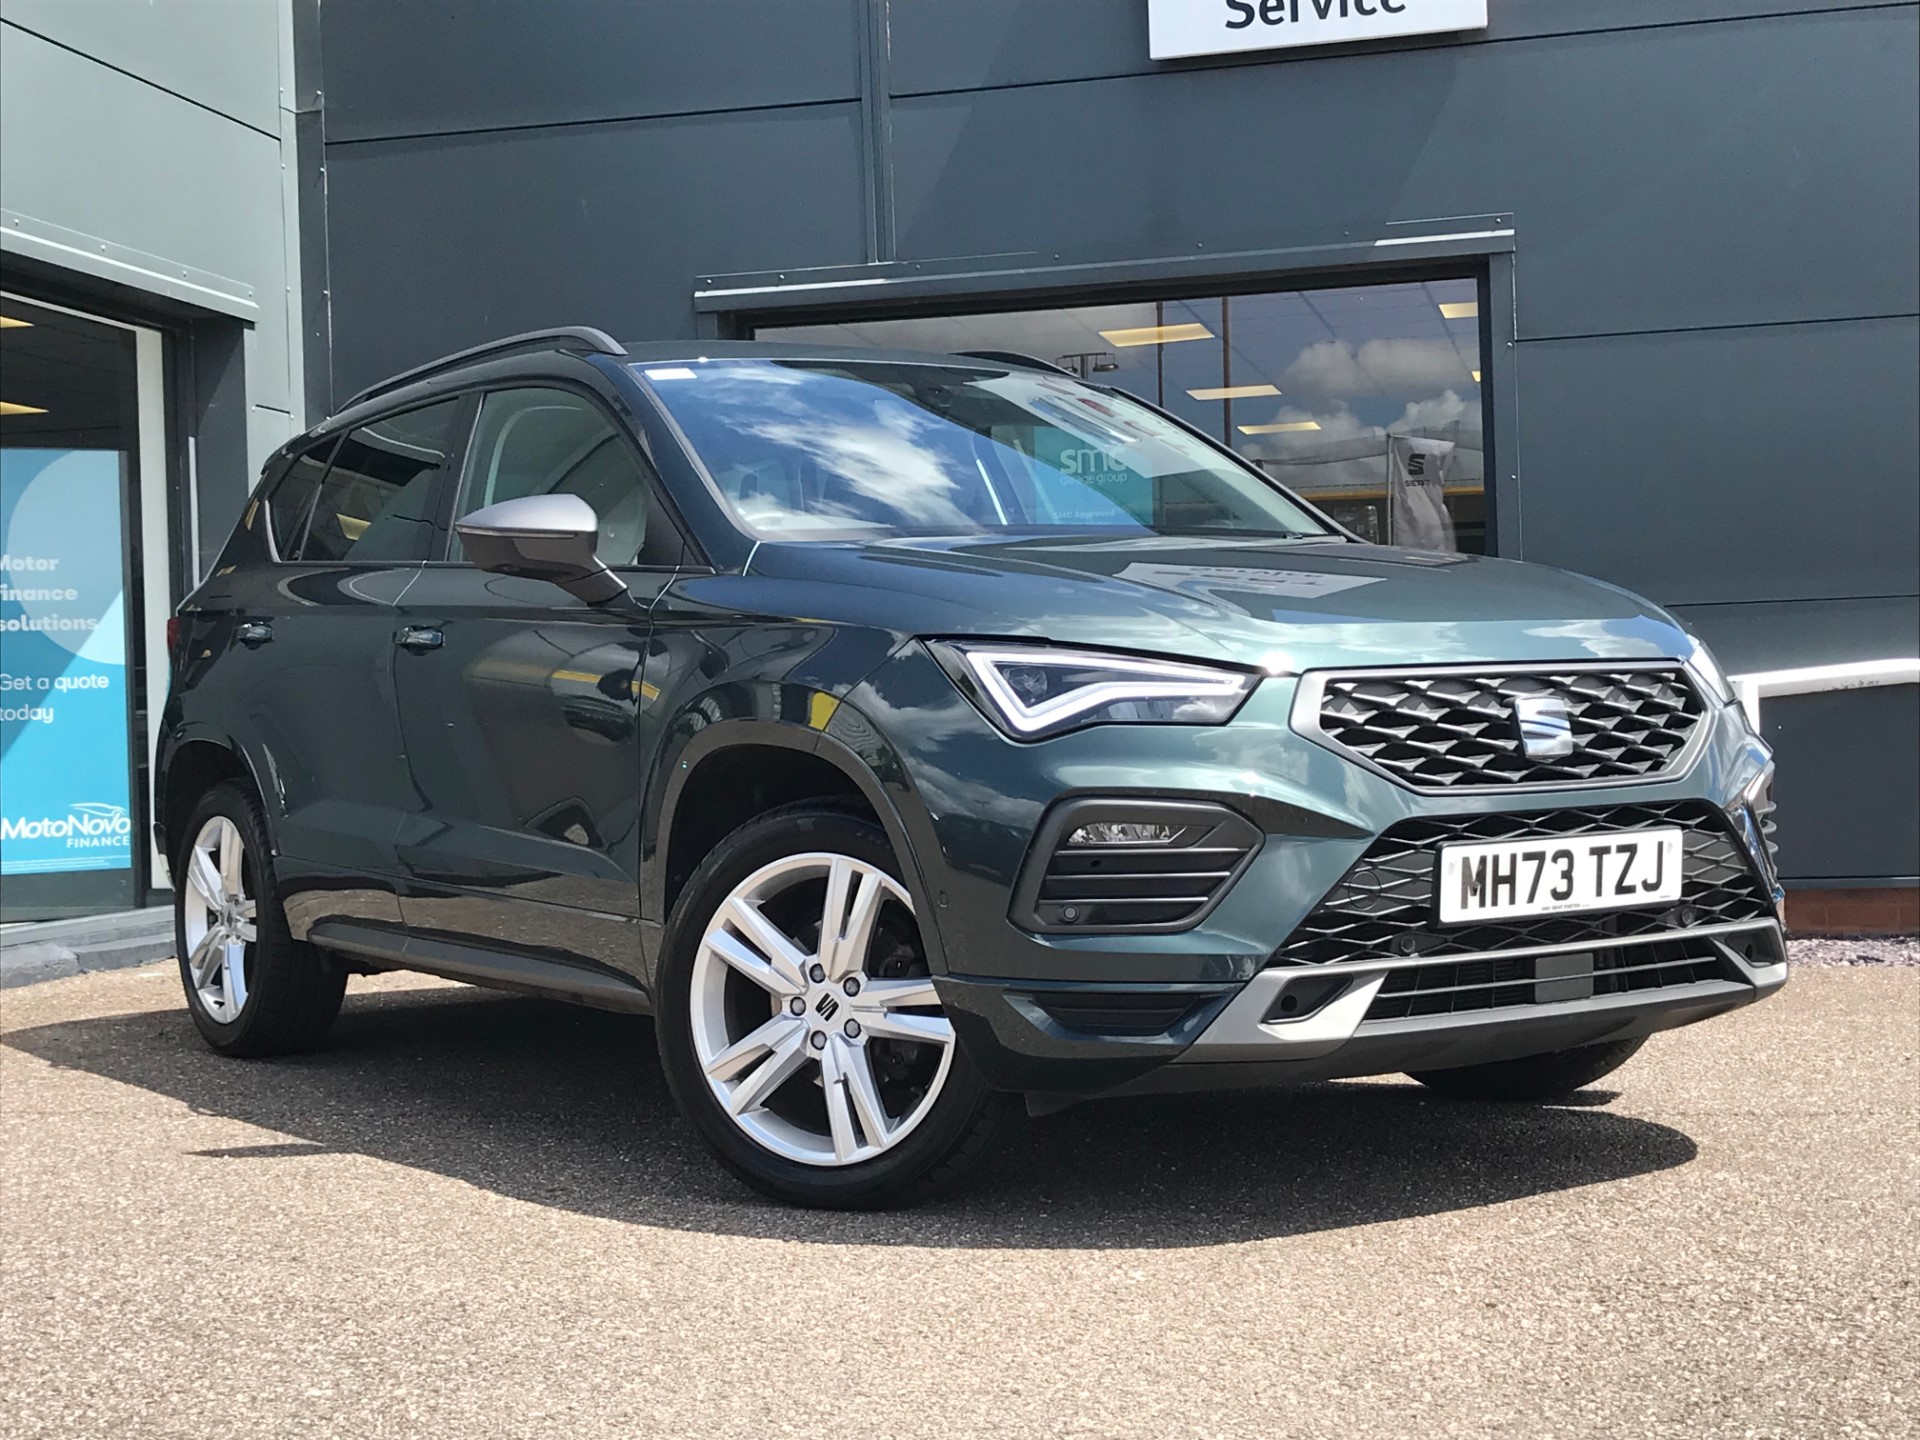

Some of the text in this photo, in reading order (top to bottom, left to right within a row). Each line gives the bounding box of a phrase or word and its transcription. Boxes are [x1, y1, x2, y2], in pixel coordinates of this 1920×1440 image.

[1060, 447, 1127, 474] smc
[1097, 473, 1127, 485] group
[0, 583, 78, 601] inance
[0, 673, 110, 693] Get a quote
[0, 703, 54, 724] today
[1, 812, 131, 840] MotoNovo
[66, 836, 130, 848] FINANCE
[1461, 841, 1664, 910] MH73 TZJ
